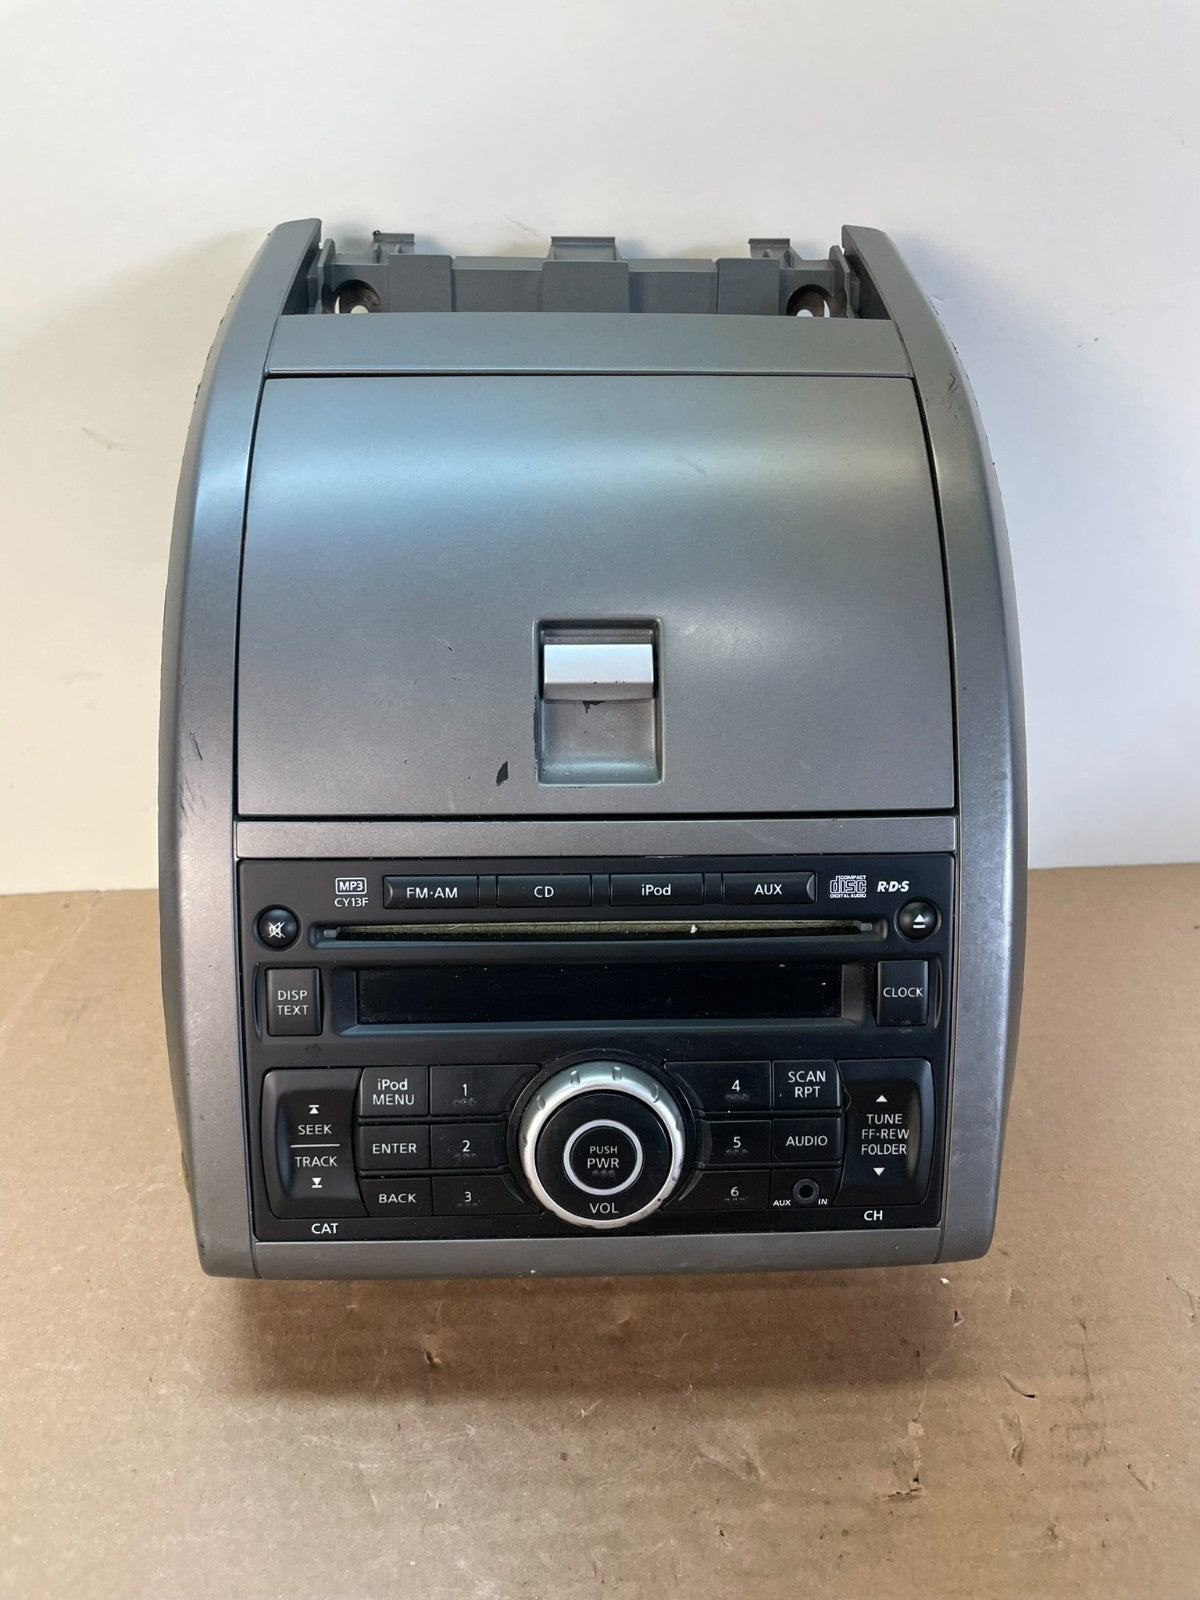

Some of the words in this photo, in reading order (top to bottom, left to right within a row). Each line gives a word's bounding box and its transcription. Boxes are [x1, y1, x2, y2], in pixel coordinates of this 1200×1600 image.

[339, 881, 364, 892] MP3
[534, 886, 554, 898] CD
[641, 884, 672, 896] iPod
[754, 884, 782, 896] AUX
[334, 898, 369, 908] CY13F
[278, 990, 308, 1001] DISP
[883, 987, 924, 998] CLOCK
[276, 1005, 309, 1016] TEXT
[788, 1070, 826, 1083] SCAN
[378, 1078, 408, 1091] iPod
[462, 1084, 468, 1096] 1
[731, 1080, 740, 1092] 4
[794, 1086, 821, 1098] RPT
[372, 1094, 415, 1105] MENU
[866, 1114, 903, 1124] TUNE
[298, 1124, 332, 1136] SEEK
[462, 1140, 471, 1152] 2
[733, 1136, 741, 1148] 5
[786, 1136, 828, 1147] AUDIO
[372, 1143, 418, 1154] ENTER
[590, 1146, 618, 1154] PUSH
[862, 1144, 907, 1155] FOLDER
[294, 1156, 338, 1168] TRACK
[587, 1158, 620, 1168] PWR
[464, 1192, 472, 1202] 3
[730, 1186, 740, 1197] 6
[378, 1193, 416, 1204] BACK
[590, 1202, 619, 1214] VOL
[864, 1210, 883, 1220] CH
[311, 1223, 338, 1234] CAT
